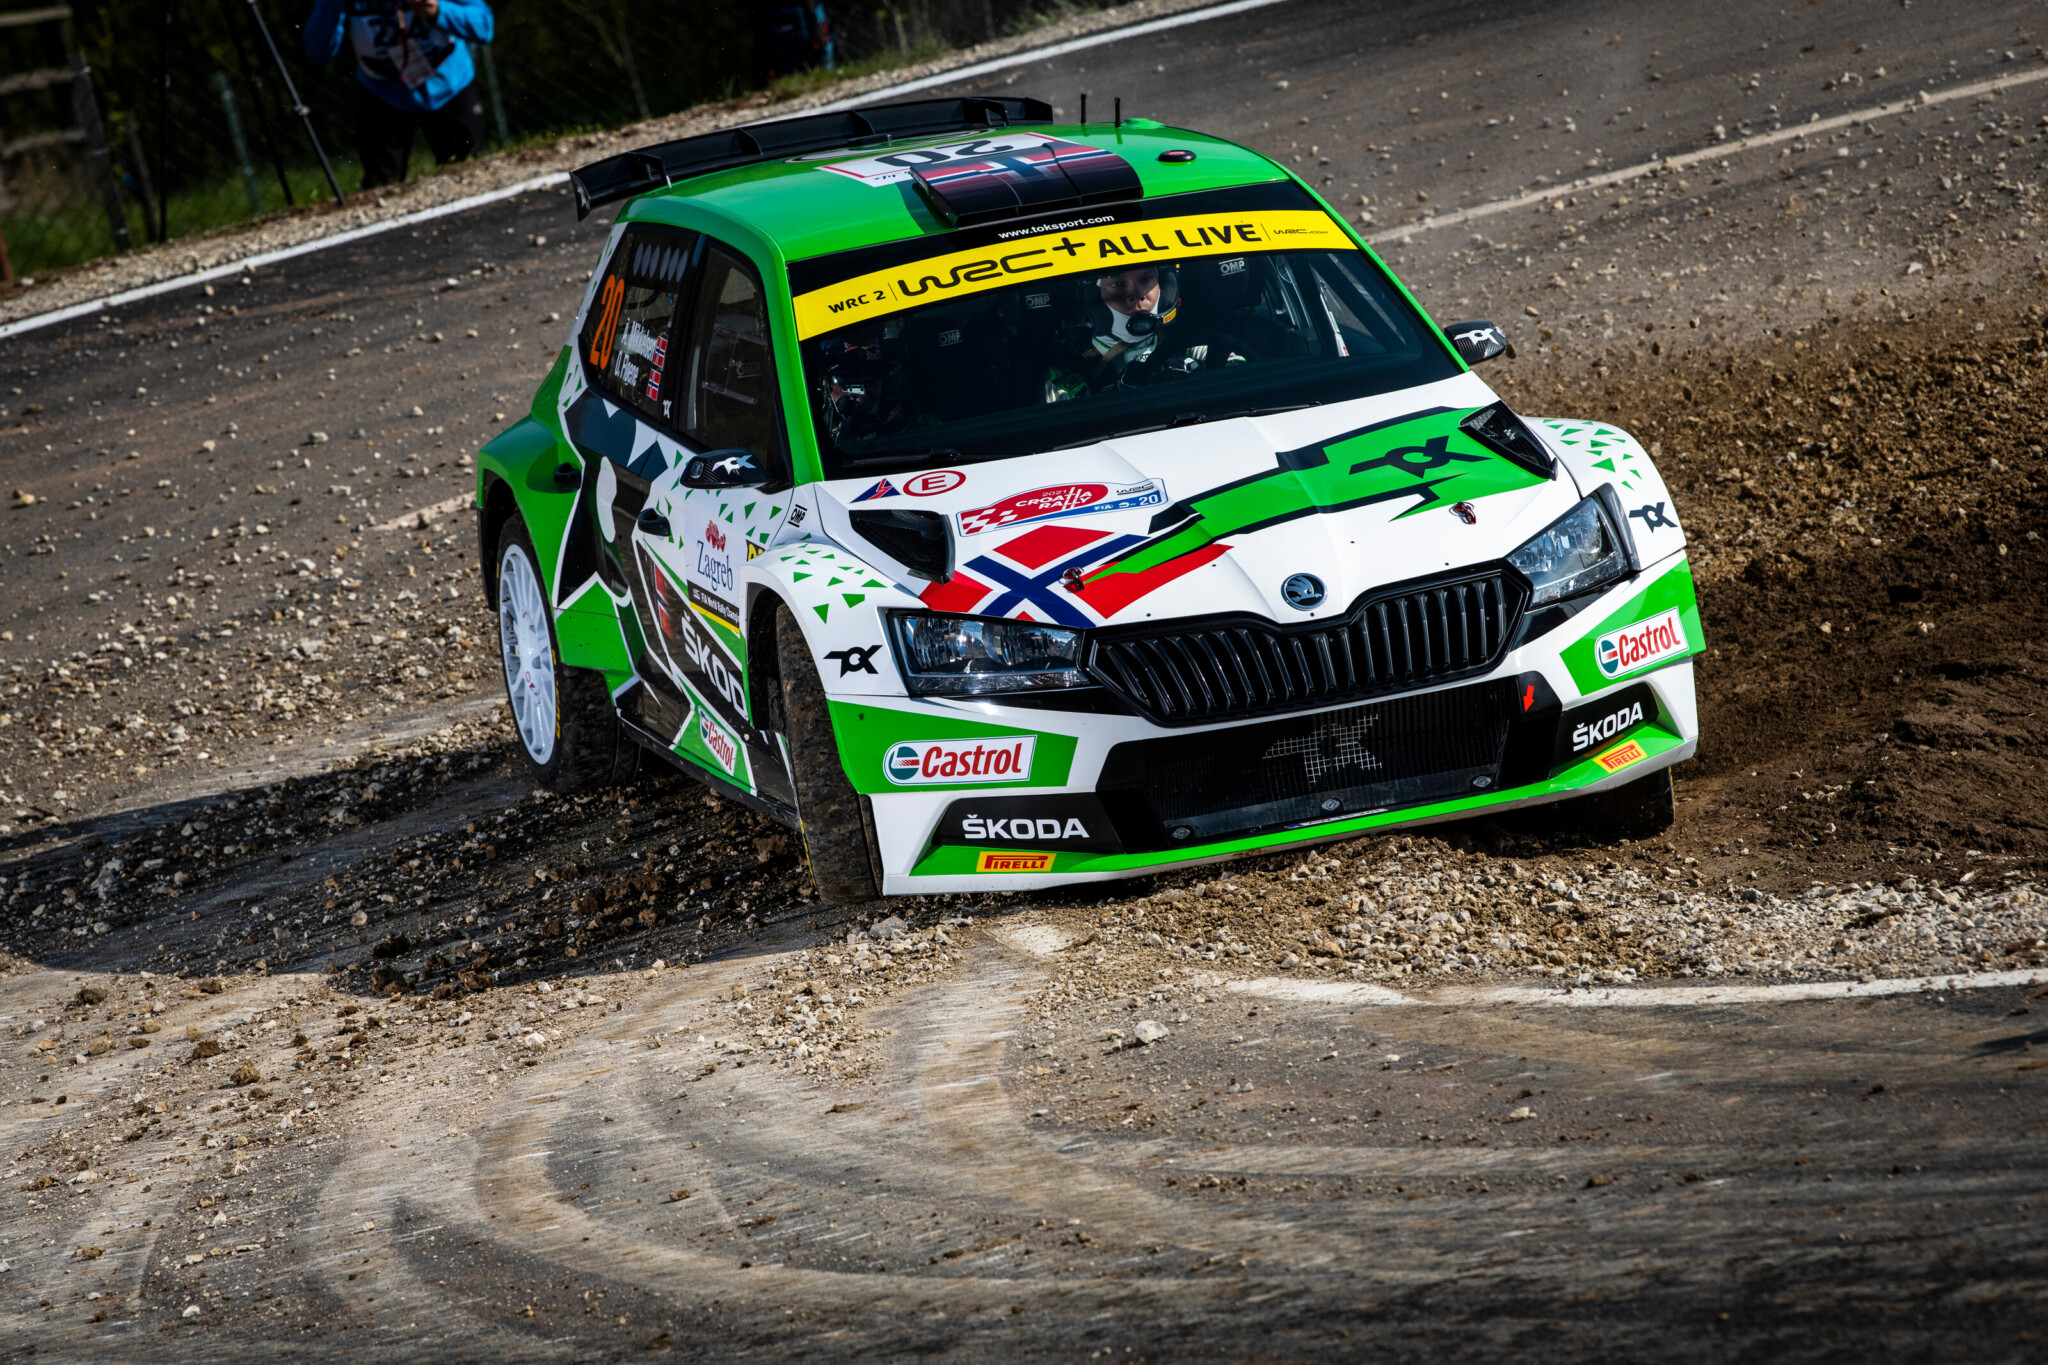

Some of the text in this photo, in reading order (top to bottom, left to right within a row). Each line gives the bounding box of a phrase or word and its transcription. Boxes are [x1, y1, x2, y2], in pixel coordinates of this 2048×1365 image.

[998, 214, 1115, 240] www.toksport.com
[1099, 233, 1169, 259] ALL
[1177, 223, 1263, 248] LIVE
[1220, 260, 1245, 274] OMP
[828, 290, 887, 314] WRC 2
[1025, 295, 1050, 307] OMP
[589, 274, 625, 370] 20
[921, 475, 948, 492] E
[1042, 489, 1067, 497] 2021
[1015, 487, 1093, 507] CROATIA
[1138, 494, 1159, 506] 20
[697, 540, 733, 592] Zagreb
[1618, 616, 1681, 667] Castrol
[1572, 701, 1644, 752] ŠKODA
[708, 721, 734, 771] Castrol
[1600, 743, 1643, 771] PIRELLI
[921, 742, 1023, 778] Castrol
[961, 814, 1090, 840] ŠKODA
[983, 854, 1048, 871] PIRELLI
